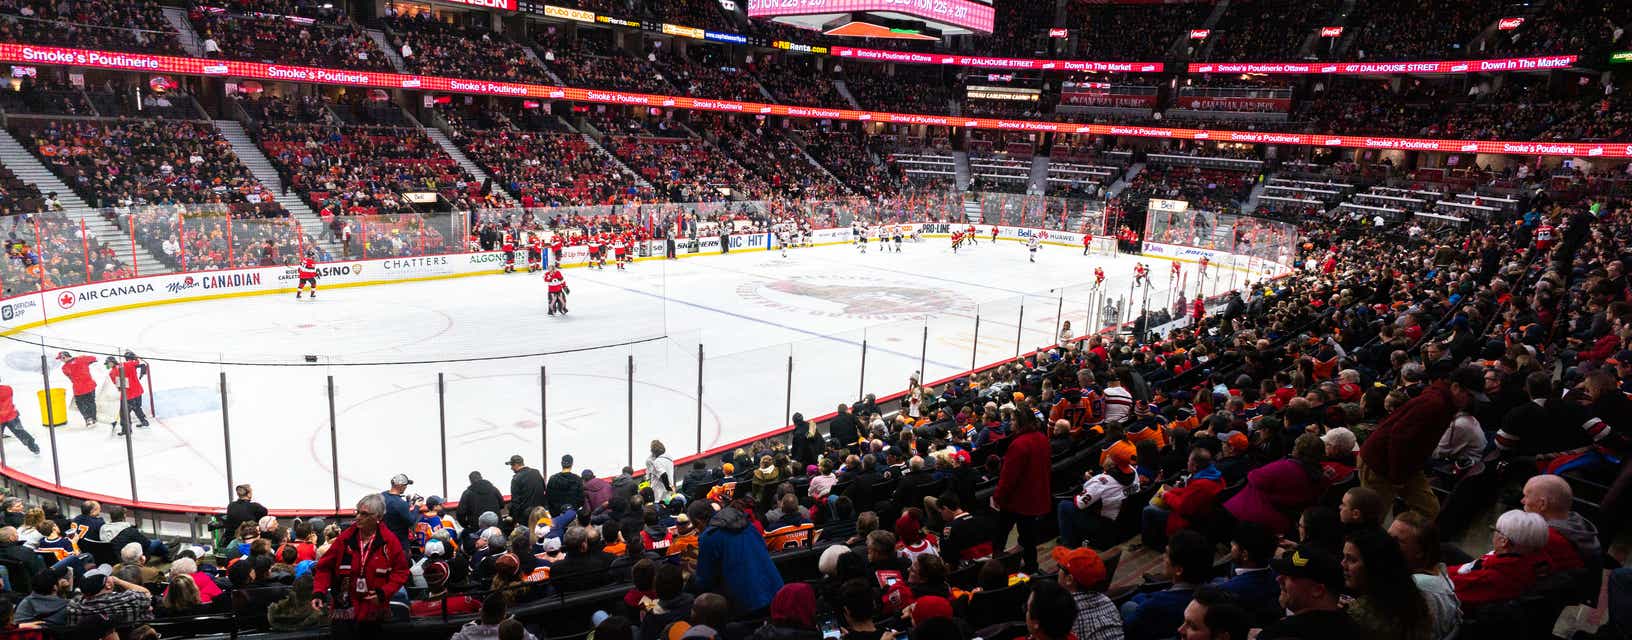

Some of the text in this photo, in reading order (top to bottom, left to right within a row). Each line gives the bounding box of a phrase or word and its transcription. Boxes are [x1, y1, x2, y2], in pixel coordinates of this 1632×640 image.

[933, 2, 948, 15] 225
[954, 8, 968, 18] 207
[23, 48, 159, 69] Smoke's Poutinerie
[1481, 58, 1570, 70] Down In The Market
[1218, 64, 1246, 72] Smoke's
[1248, 64, 1282, 72] Poutinerie
[1284, 64, 1308, 72] Ottawa
[1346, 64, 1359, 72] 407
[1407, 64, 1440, 72] STREET
[268, 66, 368, 83] Smoke's Poutinerie
[450, 81, 528, 95] Smoke's Poutinerie
[587, 92, 648, 104] Smoke's Poutinerie
[1366, 139, 1438, 150] Smoke's Poutinerie
[1504, 144, 1574, 154] Smoke's Poutinerie
[1160, 200, 1176, 209] Bell
[1018, 228, 1032, 237] Bell
[748, 235, 764, 246] HIT
[316, 266, 350, 277] ASINO
[203, 272, 260, 289] CANADIAN
[78, 283, 154, 302] AIR CANADA
[14, 300, 36, 310] OFFICIAL
